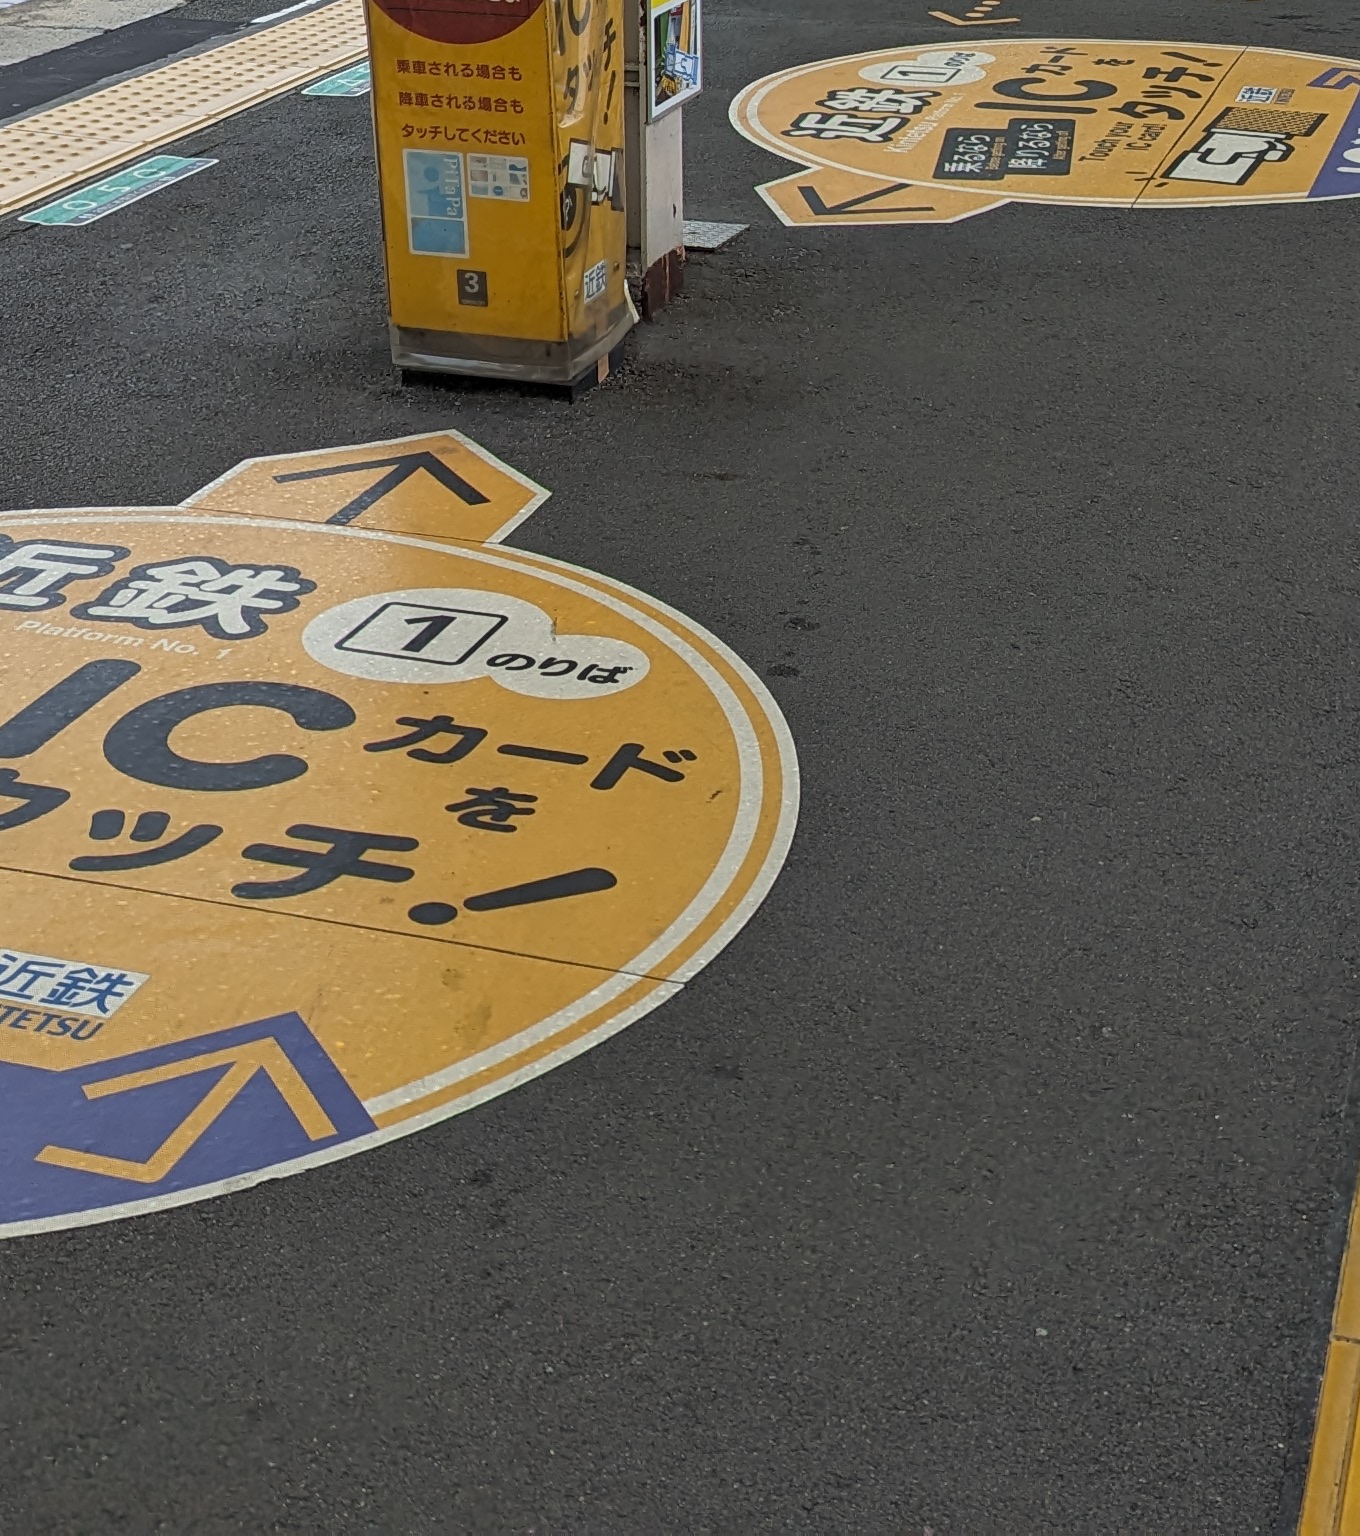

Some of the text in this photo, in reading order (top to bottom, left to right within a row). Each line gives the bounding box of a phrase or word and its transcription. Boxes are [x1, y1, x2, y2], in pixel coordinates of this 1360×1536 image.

[396, 59, 523, 82] 乗車される場合も
[1018, 46, 1089, 77] カード
[398, 91, 525, 114] 降車される場合も
[973, 77, 1119, 115] IC
[1107, 50, 1224, 121] タッチ！
[401, 123, 526, 146] タッチしてください
[781, 87, 942, 143] 近鉄
[1138, 121, 1169, 143] card!
[944, 134, 992, 173] 乗るなら
[1007, 122, 1055, 170] 降りるなら
[1078, 120, 1135, 162] Touch your
[442, 157, 459, 217] PiTaPa
[464, 272, 480, 294] 3
[14, 619, 144, 649] Platform
[149, 636, 200, 657] No.
[216, 647, 233, 661] 1
[485, 652, 636, 685] のりば
[362, 714, 700, 792] カード
[444, 786, 540, 835] を
